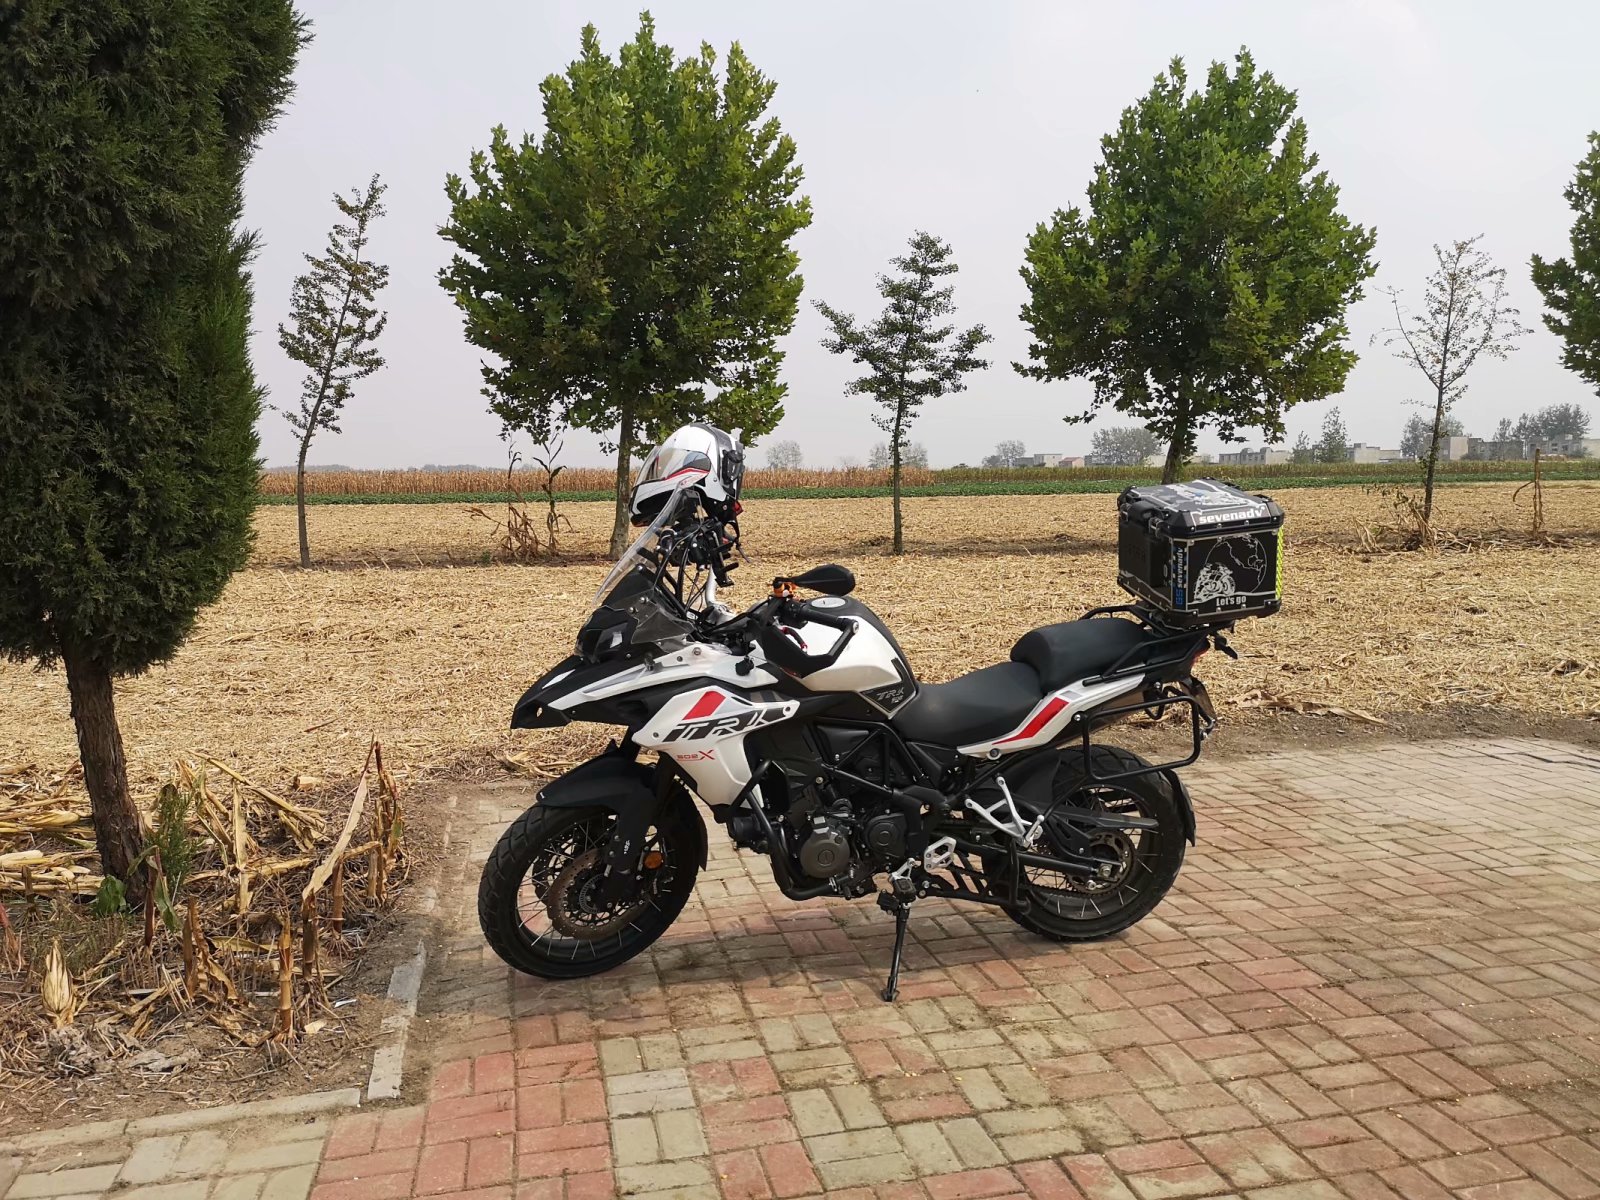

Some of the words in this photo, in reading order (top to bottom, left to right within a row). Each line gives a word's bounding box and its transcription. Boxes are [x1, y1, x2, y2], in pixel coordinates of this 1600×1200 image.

[1199, 508, 1263, 523] sevenadv
[1216, 597, 1235, 606] Let's
[1236, 596, 1246, 604] go
[876, 687, 904, 700] TRK
[672, 708, 770, 740] TRK
